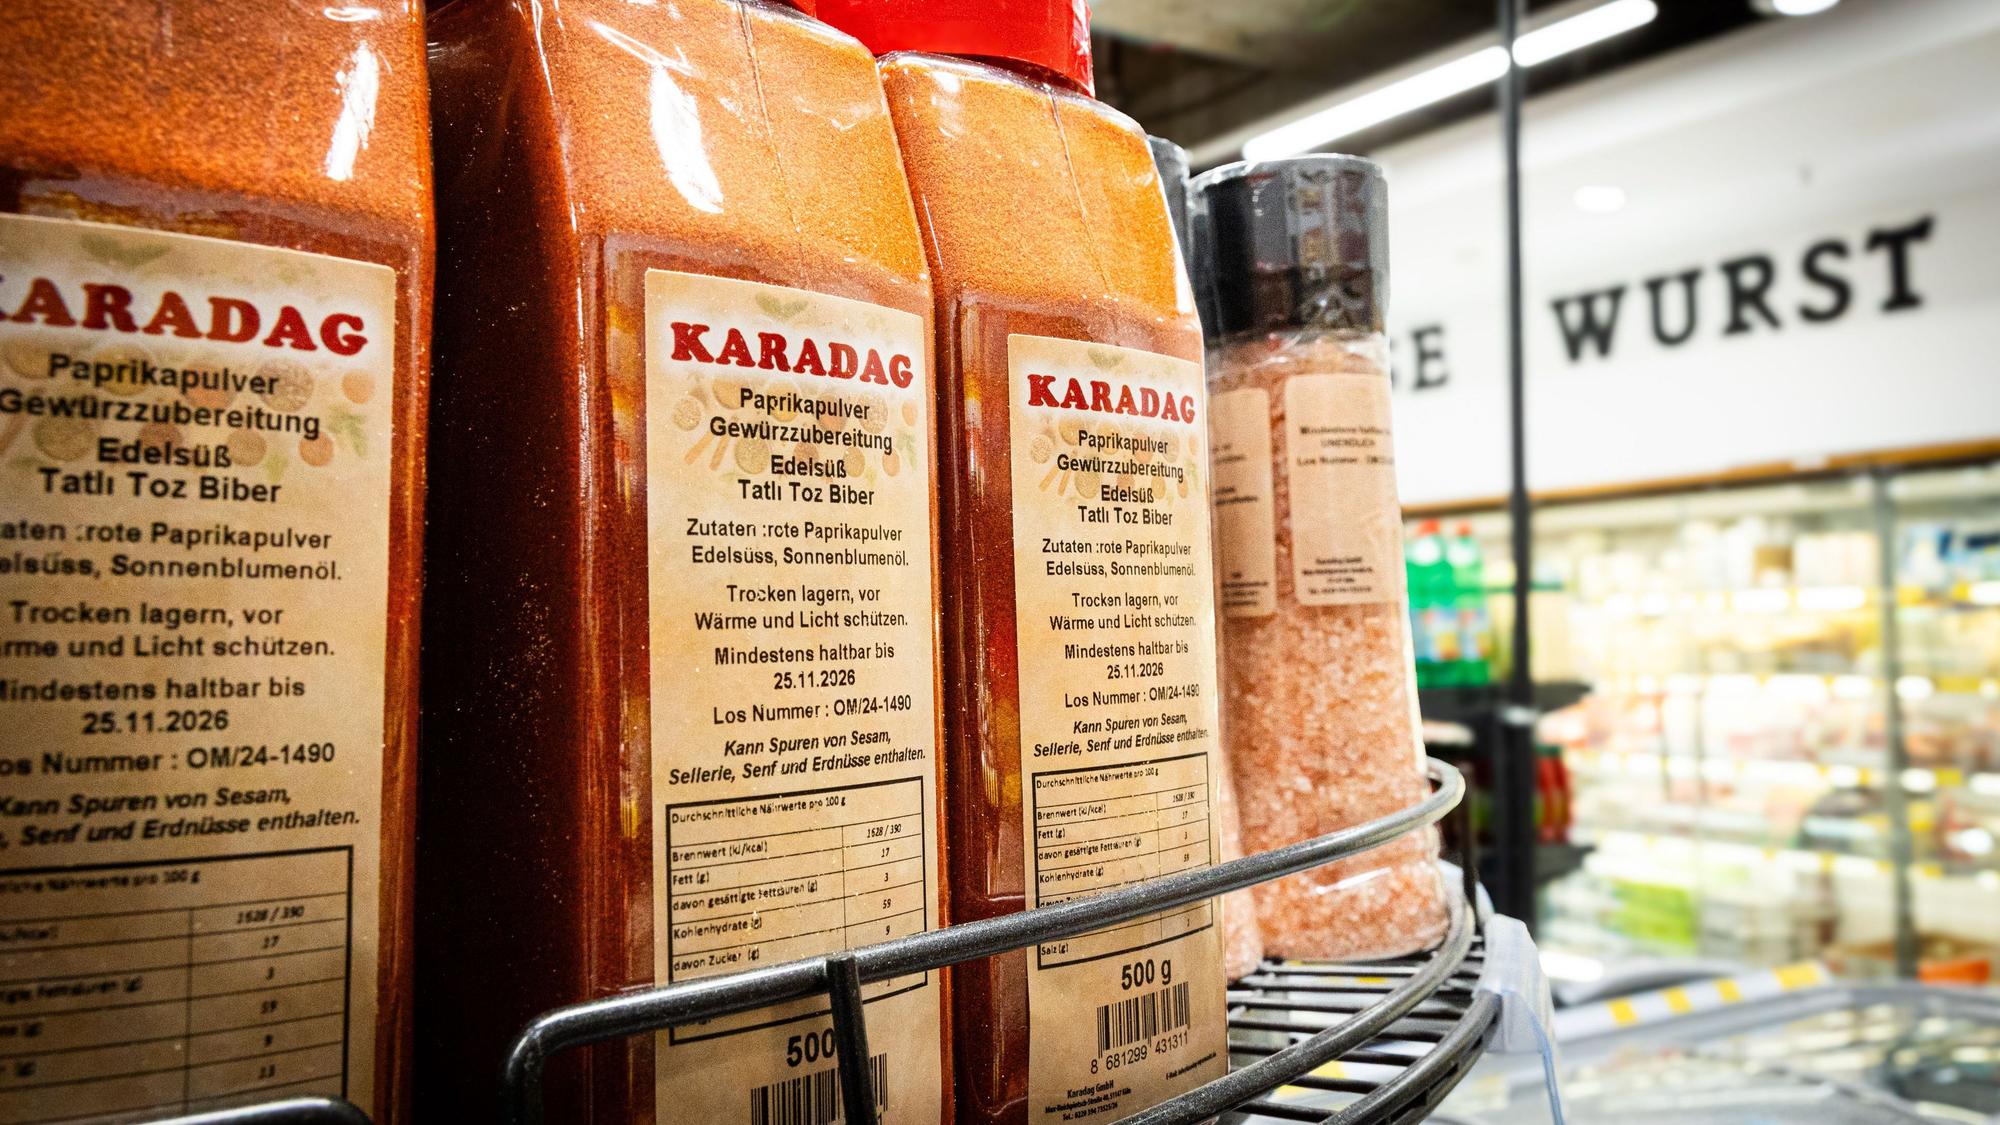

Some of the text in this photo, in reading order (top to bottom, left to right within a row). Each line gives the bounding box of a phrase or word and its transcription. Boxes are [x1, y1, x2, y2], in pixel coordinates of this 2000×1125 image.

[0, 273, 368, 356] ARADAG
[1389, 215, 1935, 391] E WURST
[671, 322, 914, 388] KARADAG
[48, 353, 279, 395] Paprikapulver
[740, 388, 870, 420] Paprikapulver
[1027, 374, 1195, 424] KARADAG
[0, 387, 320, 441] Gewürzzubereitung
[710, 416, 892, 455] Gewürzzubereitung
[1078, 430, 1168, 454] Paprikapulver
[97, 438, 232, 468] Edelsüß
[771, 455, 846, 478] Edelsüß
[1057, 454, 1184, 482] Gewürzzubereitung
[39, 467, 282, 503] Tatlı Toz Biber
[738, 479, 874, 505] Tatlı Toz Biber
[1101, 485, 1154, 503] Edelsüß
[1078, 505, 1172, 526] Tatlı Toz Biber
[151, 522, 332, 552] Paprikapulver
[687, 518, 756, 537] Zutaten
[805, 522, 902, 544] Paprikapulver
[692, 546, 909, 567] Edelsüss, Sonnenblumenöl.
[1042, 538, 1191, 560] Zutaten :rote Paprikapulver
[111, 554, 342, 581] Sonnenblumenöl.
[1046, 561, 1196, 578] Edelsüss, Sonnenblumenöl.
[727, 585, 881, 605] Trocken lagern, vor
[1072, 592, 1178, 609] Trocken lagern, vor
[9, 601, 283, 630] Trocken lagern, vor
[695, 610, 908, 630] Wärme und Licht schützen.
[1050, 613, 1196, 631] Wärme und Licht schützen.
[68, 635, 335, 657] und Licht schützen.
[715, 642, 894, 665] Mindestens haltbar bis
[1065, 639, 1188, 659] Mindestens haltbar bis
[774, 669, 855, 689] 25.11.2026
[1107, 662, 1164, 679] 25.11.2026
[166, 677, 260, 699] haltbar
[269, 676, 305, 697] bis
[1065, 684, 1199, 708] Los Nummer OM/24-1490
[714, 706, 746, 724] Los
[753, 703, 819, 722] Nummer
[834, 694, 911, 717] OM/24-1490
[82, 709, 229, 734] 25.11.2026
[1073, 713, 1187, 734] Kann Spuren von Sesam,
[724, 730, 891, 757] Kann Spuren von Sesam,
[1033, 742, 1082, 757] Sellerie,
[1087, 738, 1112, 753] Senf
[1114, 736, 1132, 749] und
[1135, 732, 1175, 747] Erdnüsse
[42, 752, 163, 774] Nummer
[187, 742, 334, 769] OM/24-1490
[669, 748, 925, 786] Sellerie, Senf und Erdnüsse enthalten.
[68, 786, 291, 817] Spuren von Sesam,
[672, 806, 757, 823] Durchschnittliche
[760, 800, 806, 814] Nährwerte
[809, 799, 823, 810] pro
[826, 796, 839, 806] 100
[1038, 808, 1077, 820] Brennwert
[21, 822, 82, 846] Senf
[87, 821, 135, 843] und
[142, 815, 250, 840] Erdnüsse
[257, 808, 360, 832] enthalten.
[1038, 830, 1053, 839] Fett
[673, 847, 725, 862] Brennwert
[881, 848, 889, 857] 17
[1038, 849, 1062, 860] davon
[673, 874, 692, 885] Fett
[1040, 868, 1094, 884] Kohlenhydrate
[673, 897, 705, 911] davon
[707, 892, 755, 910] gesättigte
[674, 919, 748, 940] Kohlenhydrate
[674, 957, 705, 971] davon
[709, 952, 741, 968] Zucker
[1041, 945, 1057, 956] Salz
[1121, 958, 1171, 990] 500 g
[786, 1027, 836, 1068] 500
[1090, 1059, 1098, 1075] 8
[1106, 1045, 1148, 1070] 681299
[1155, 1030, 1188, 1054] 431311
[1067, 1080, 1114, 1098] Karadag GmbH
